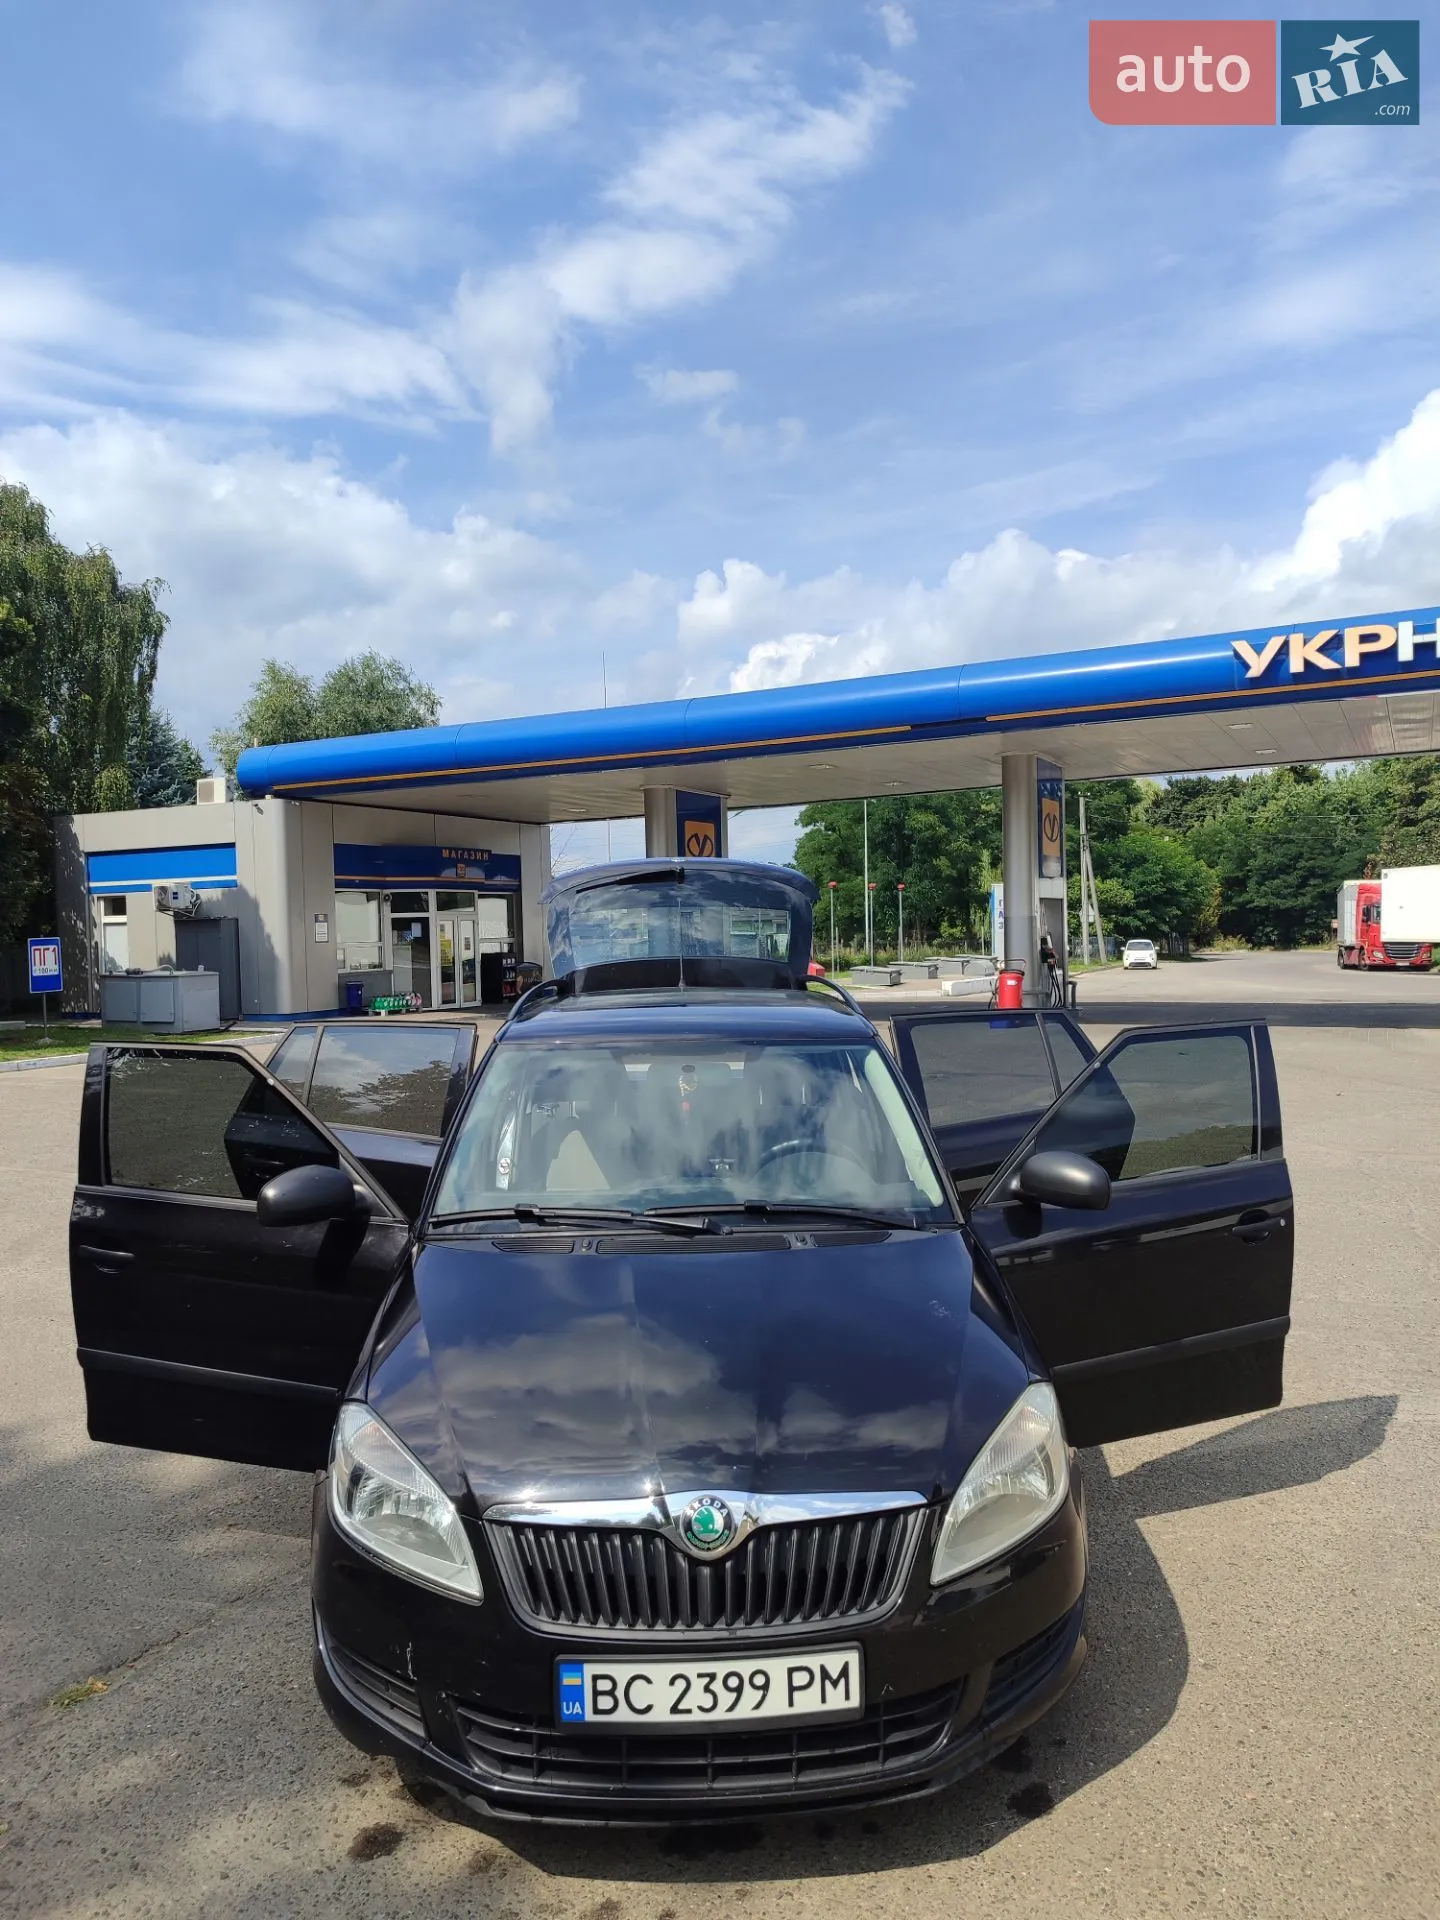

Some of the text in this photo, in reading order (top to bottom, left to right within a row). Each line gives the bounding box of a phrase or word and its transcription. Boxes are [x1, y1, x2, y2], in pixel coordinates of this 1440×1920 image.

[442, 849, 489, 860] МАГАЗИН
[591, 1660, 850, 1716] BC 2399 PM
[563, 1701, 583, 1714] UA
